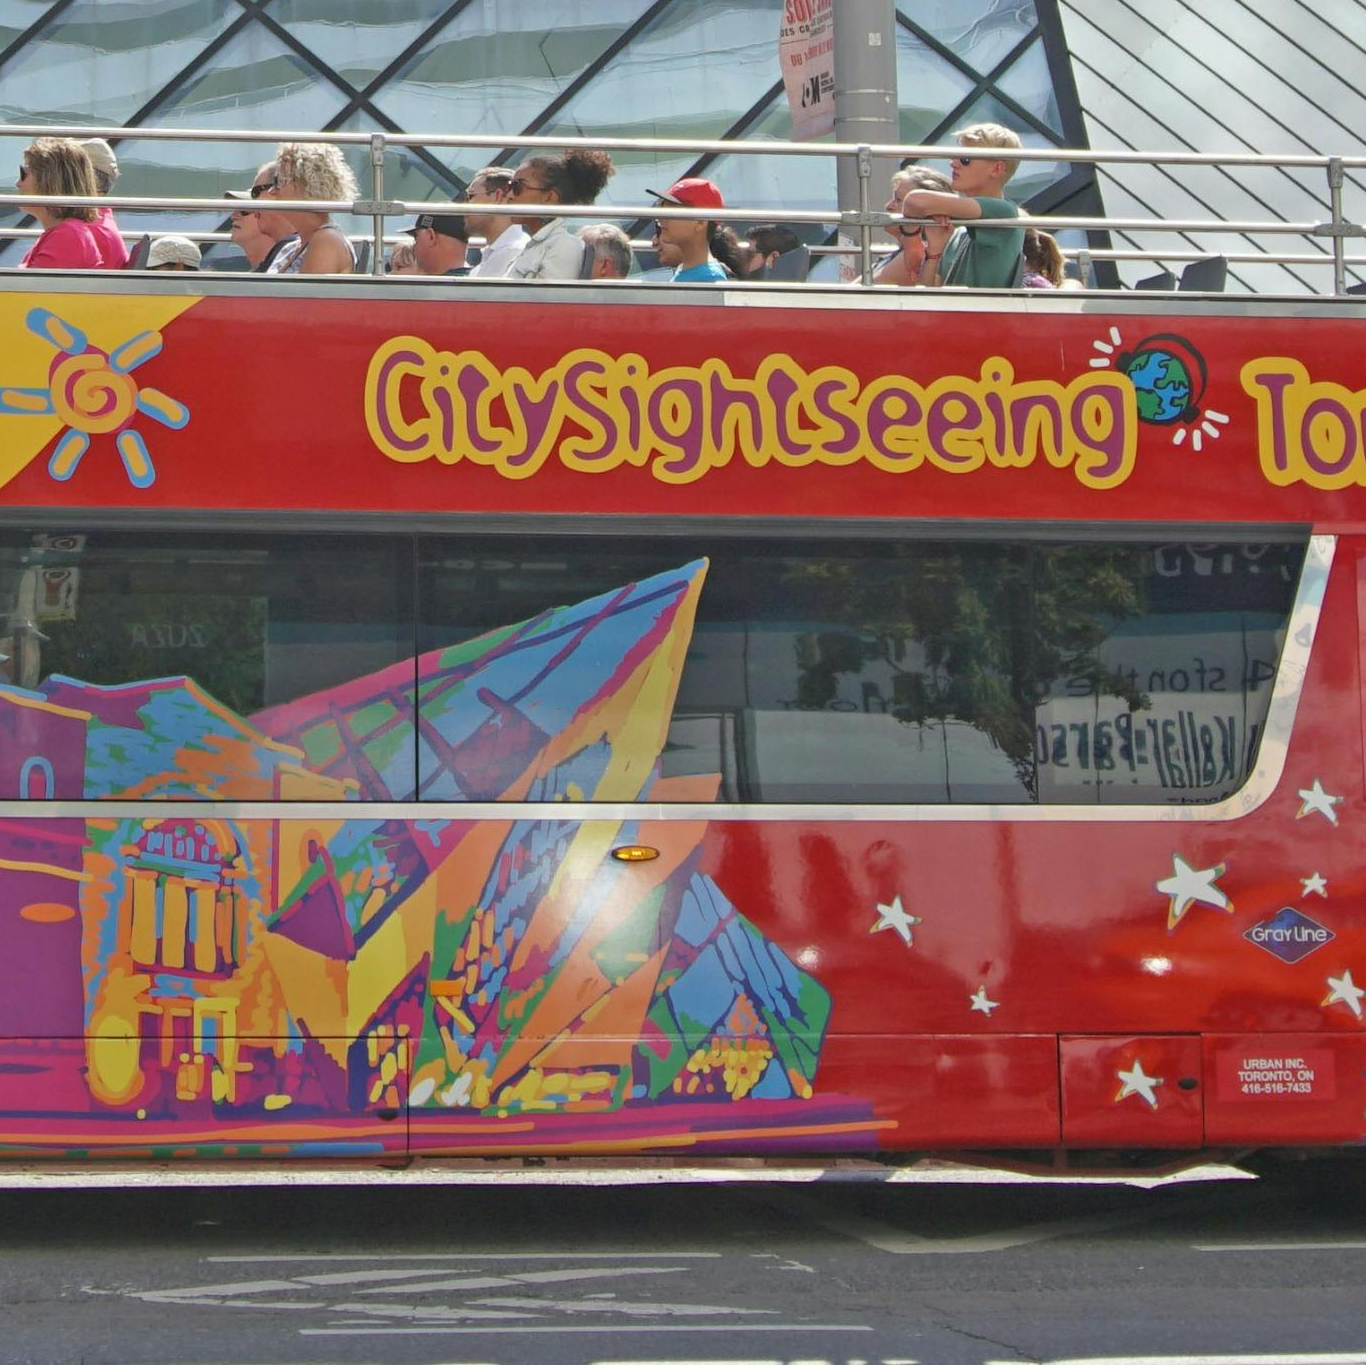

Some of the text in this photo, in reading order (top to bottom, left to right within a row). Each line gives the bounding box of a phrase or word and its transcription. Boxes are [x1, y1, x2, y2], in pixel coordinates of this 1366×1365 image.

[364, 336, 1137, 489] CitySightseeing
[1243, 1058, 1308, 1069] URBAN INC.
[1238, 1070, 1315, 1082] TORONTO, ON
